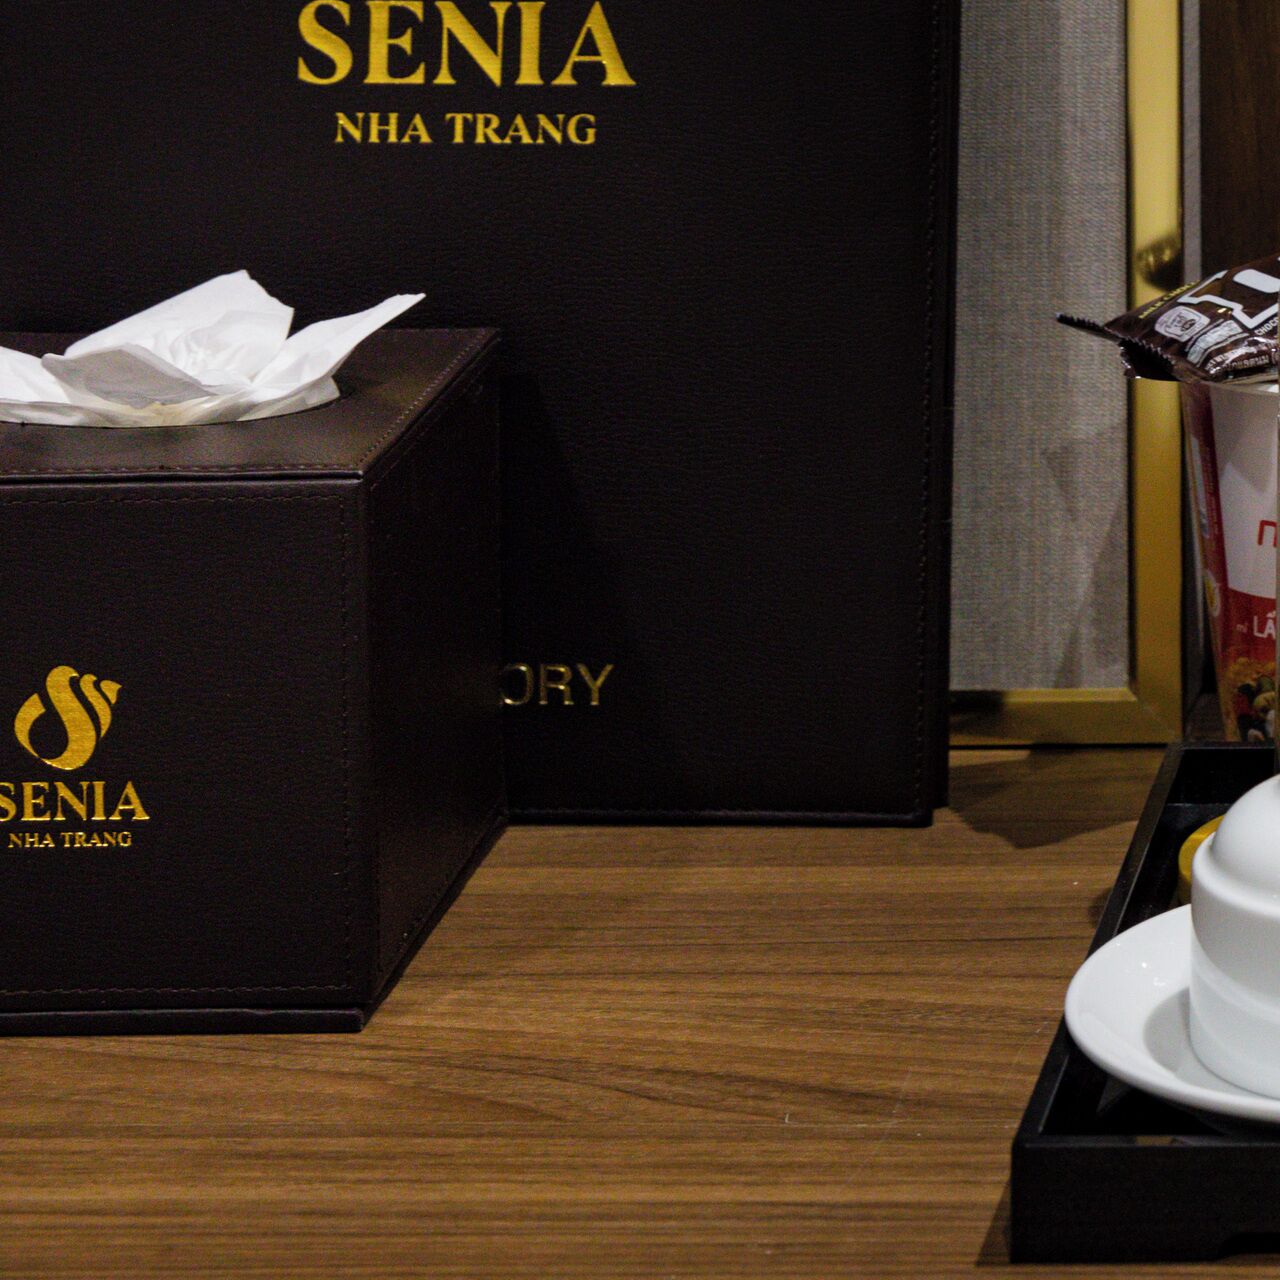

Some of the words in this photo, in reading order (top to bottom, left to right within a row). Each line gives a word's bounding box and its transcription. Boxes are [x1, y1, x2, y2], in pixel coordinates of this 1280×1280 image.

[334, 112, 432, 144] NHA
[445, 112, 597, 145] TRANG
[0, 781, 150, 821] SENIA
[8, 832, 55, 848] NHA
[60, 831, 132, 847] TRANG
